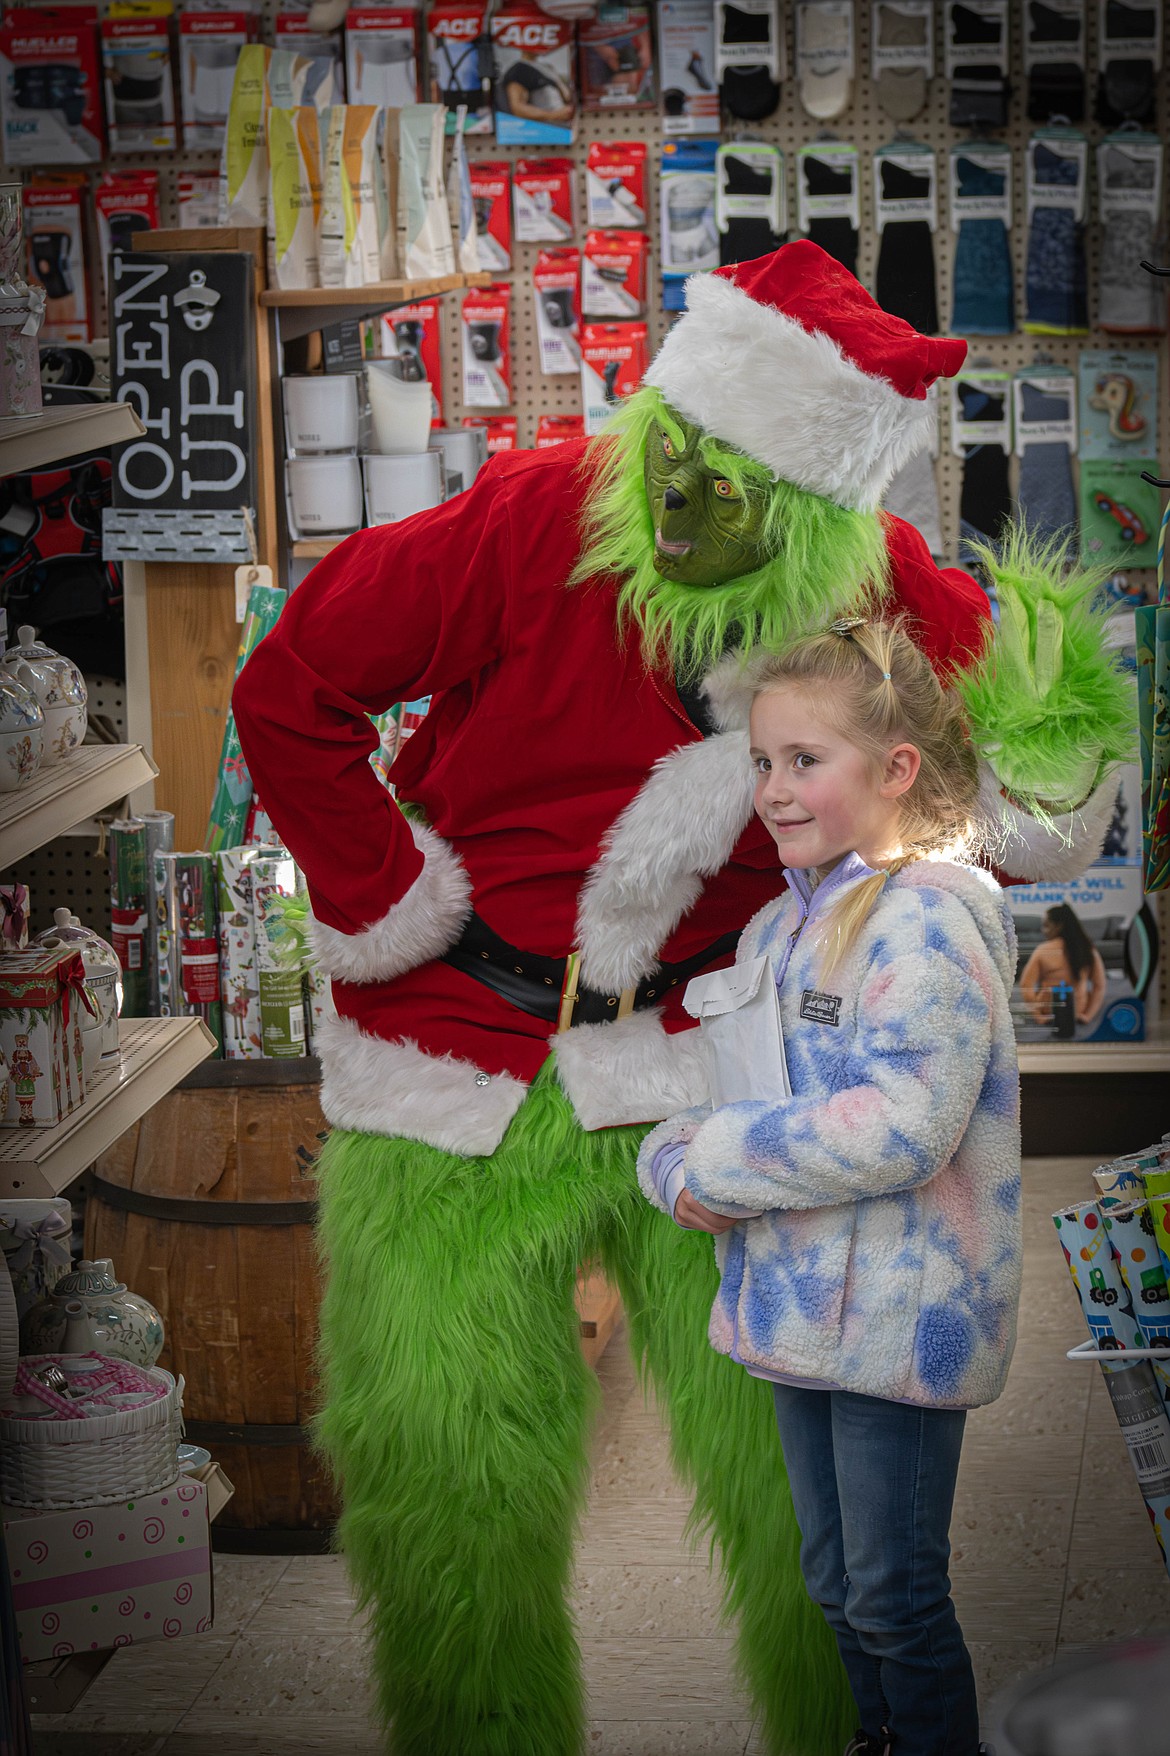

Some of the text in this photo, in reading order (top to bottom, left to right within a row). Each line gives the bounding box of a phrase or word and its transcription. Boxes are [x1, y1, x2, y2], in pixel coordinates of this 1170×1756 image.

[434, 18, 479, 35] ACE
[500, 24, 561, 46] ACE
[11, 36, 78, 48] MUELLER
[114, 256, 174, 500] OPEN
[180, 359, 246, 500] UP
[1086, 877, 1125, 889] WILL
[1012, 890, 1104, 904] THANK YOU
